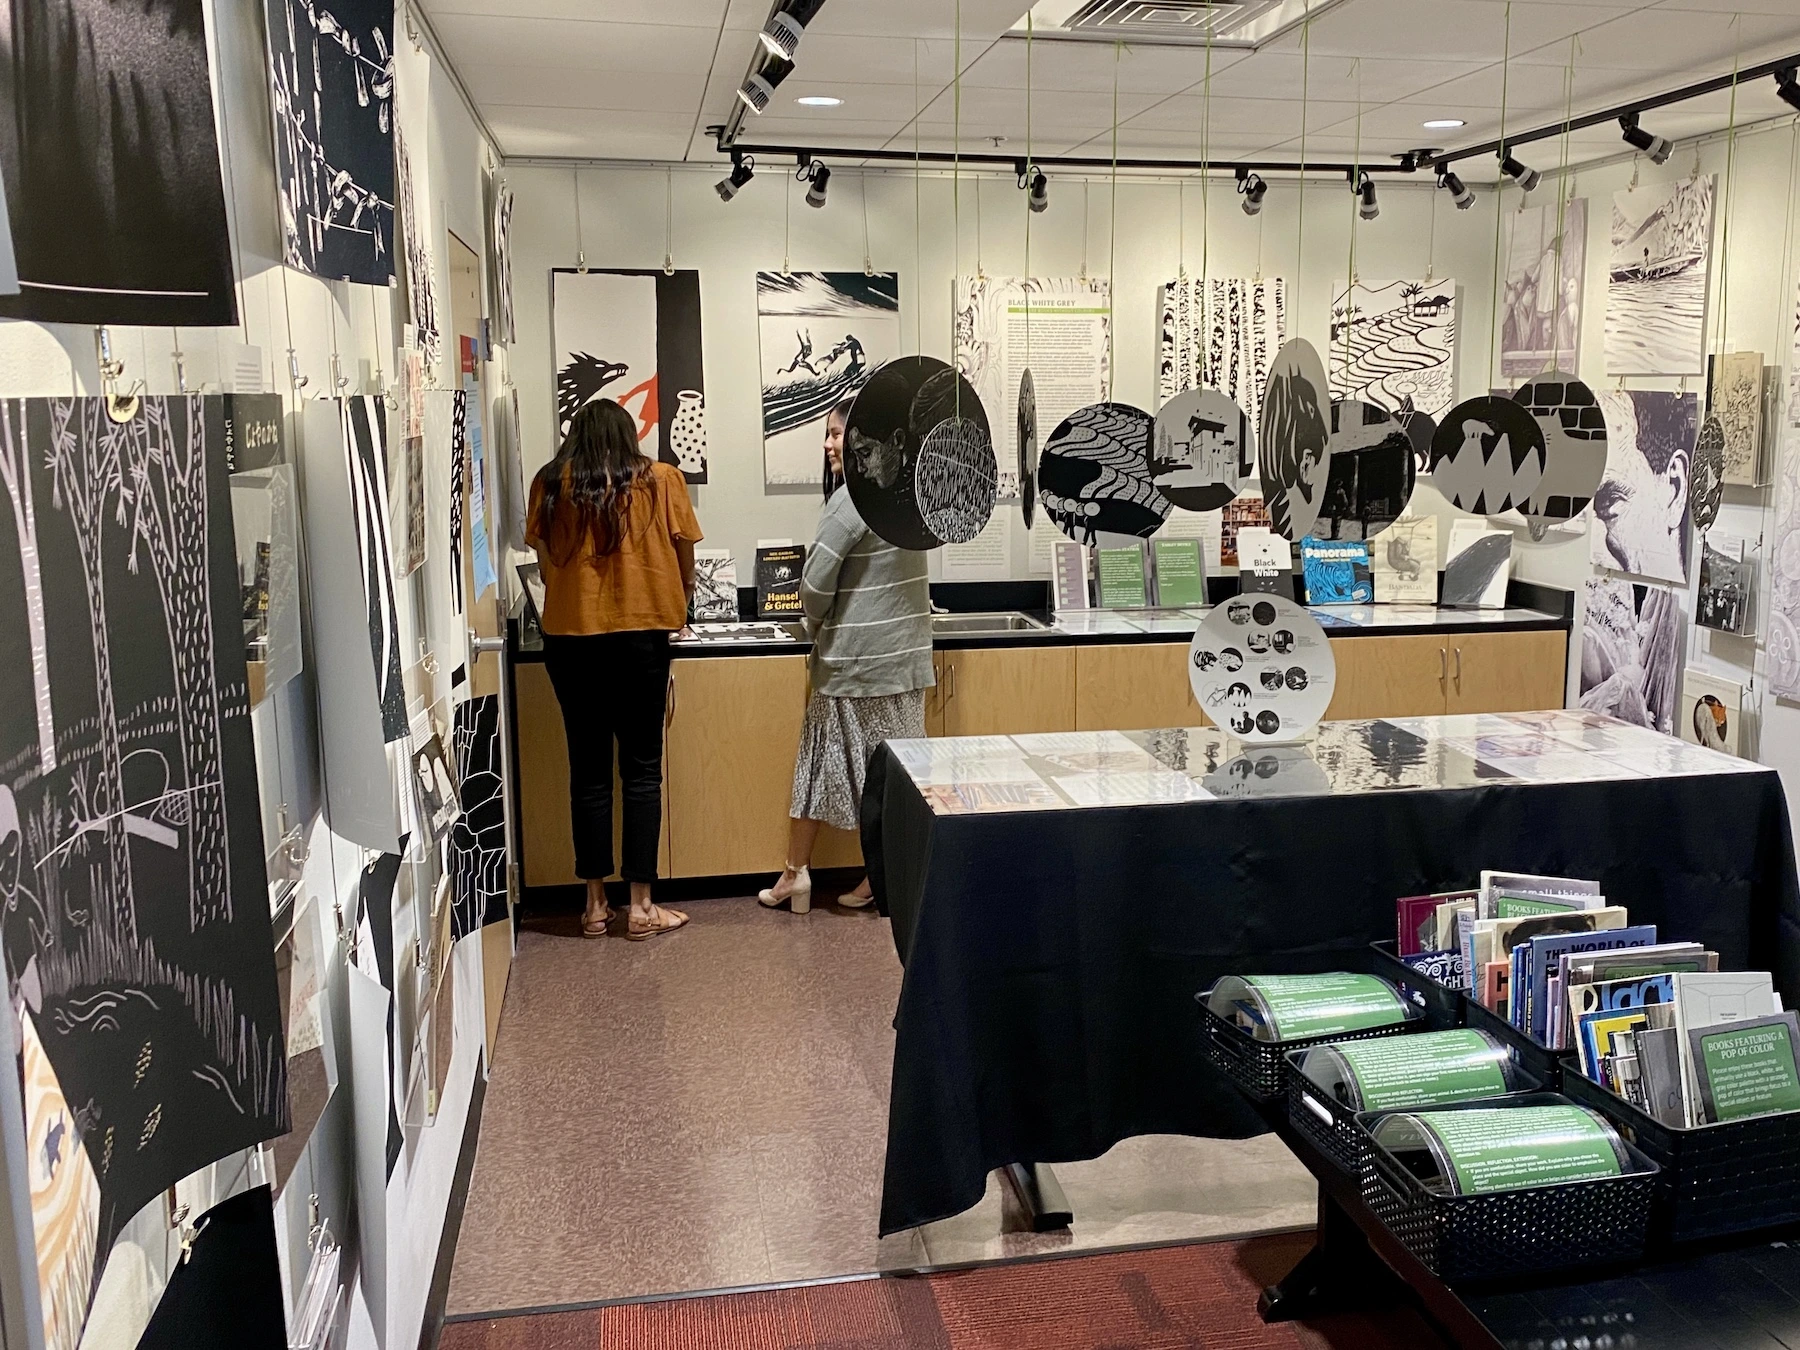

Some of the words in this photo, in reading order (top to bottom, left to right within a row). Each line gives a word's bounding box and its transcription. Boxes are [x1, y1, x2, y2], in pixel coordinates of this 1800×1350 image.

[1304, 548, 1364, 558] Panorama
[768, 591, 798, 601] Hansel
[764, 602, 773, 610] &
[774, 600, 802, 610] Gretel
[1507, 904, 1531, 914] BOOKS
[1546, 948, 1566, 960] THE
[1570, 940, 1625, 953] WORLD
[1708, 1040, 1734, 1052] BOOKS
[1734, 1032, 1777, 1047] FEATURING
[1778, 1032, 1784, 1040] A
[1721, 1049, 1737, 1059] POP
[1738, 1046, 1748, 1056] OF
[1749, 1042, 1775, 1054] COLOR
